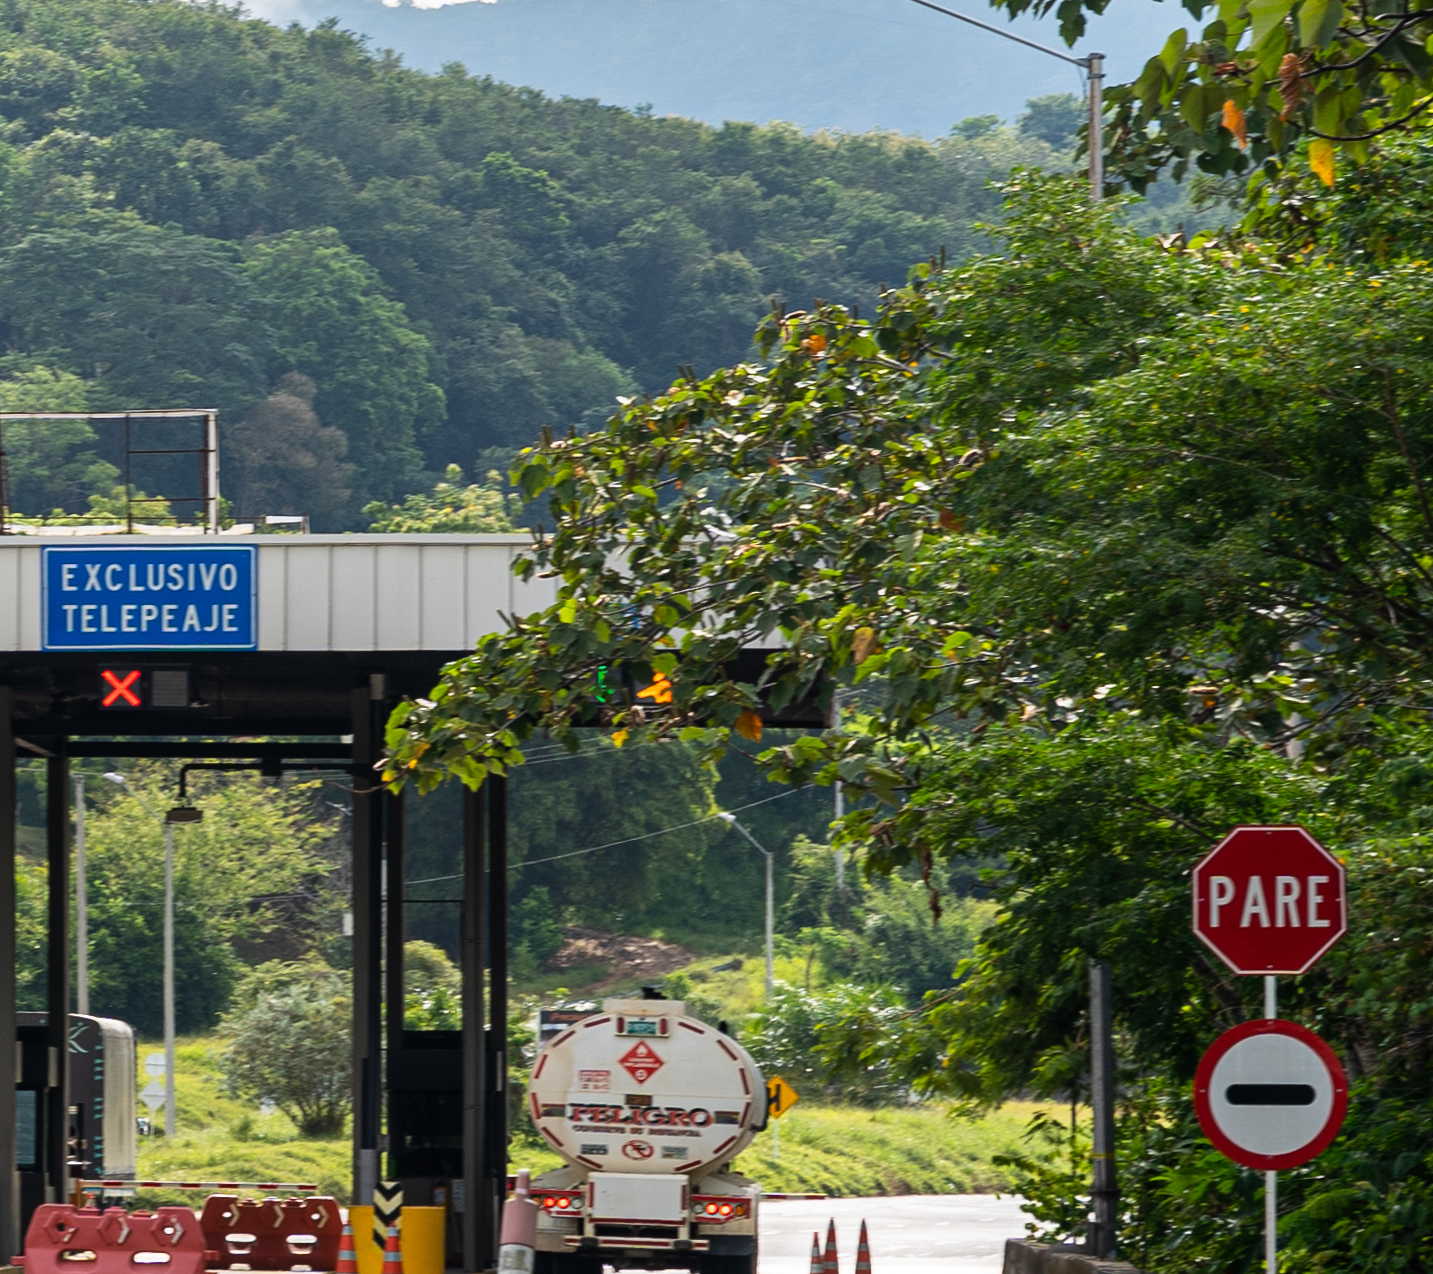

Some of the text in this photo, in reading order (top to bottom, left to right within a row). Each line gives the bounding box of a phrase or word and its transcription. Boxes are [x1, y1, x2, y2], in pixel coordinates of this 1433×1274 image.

[61, 562, 239, 592] EXCLUSIVO
[61, 603, 240, 634] TELEPEAJE
[1209, 875, 1331, 928] PARE
[568, 1103, 714, 1128] PELIGRO
